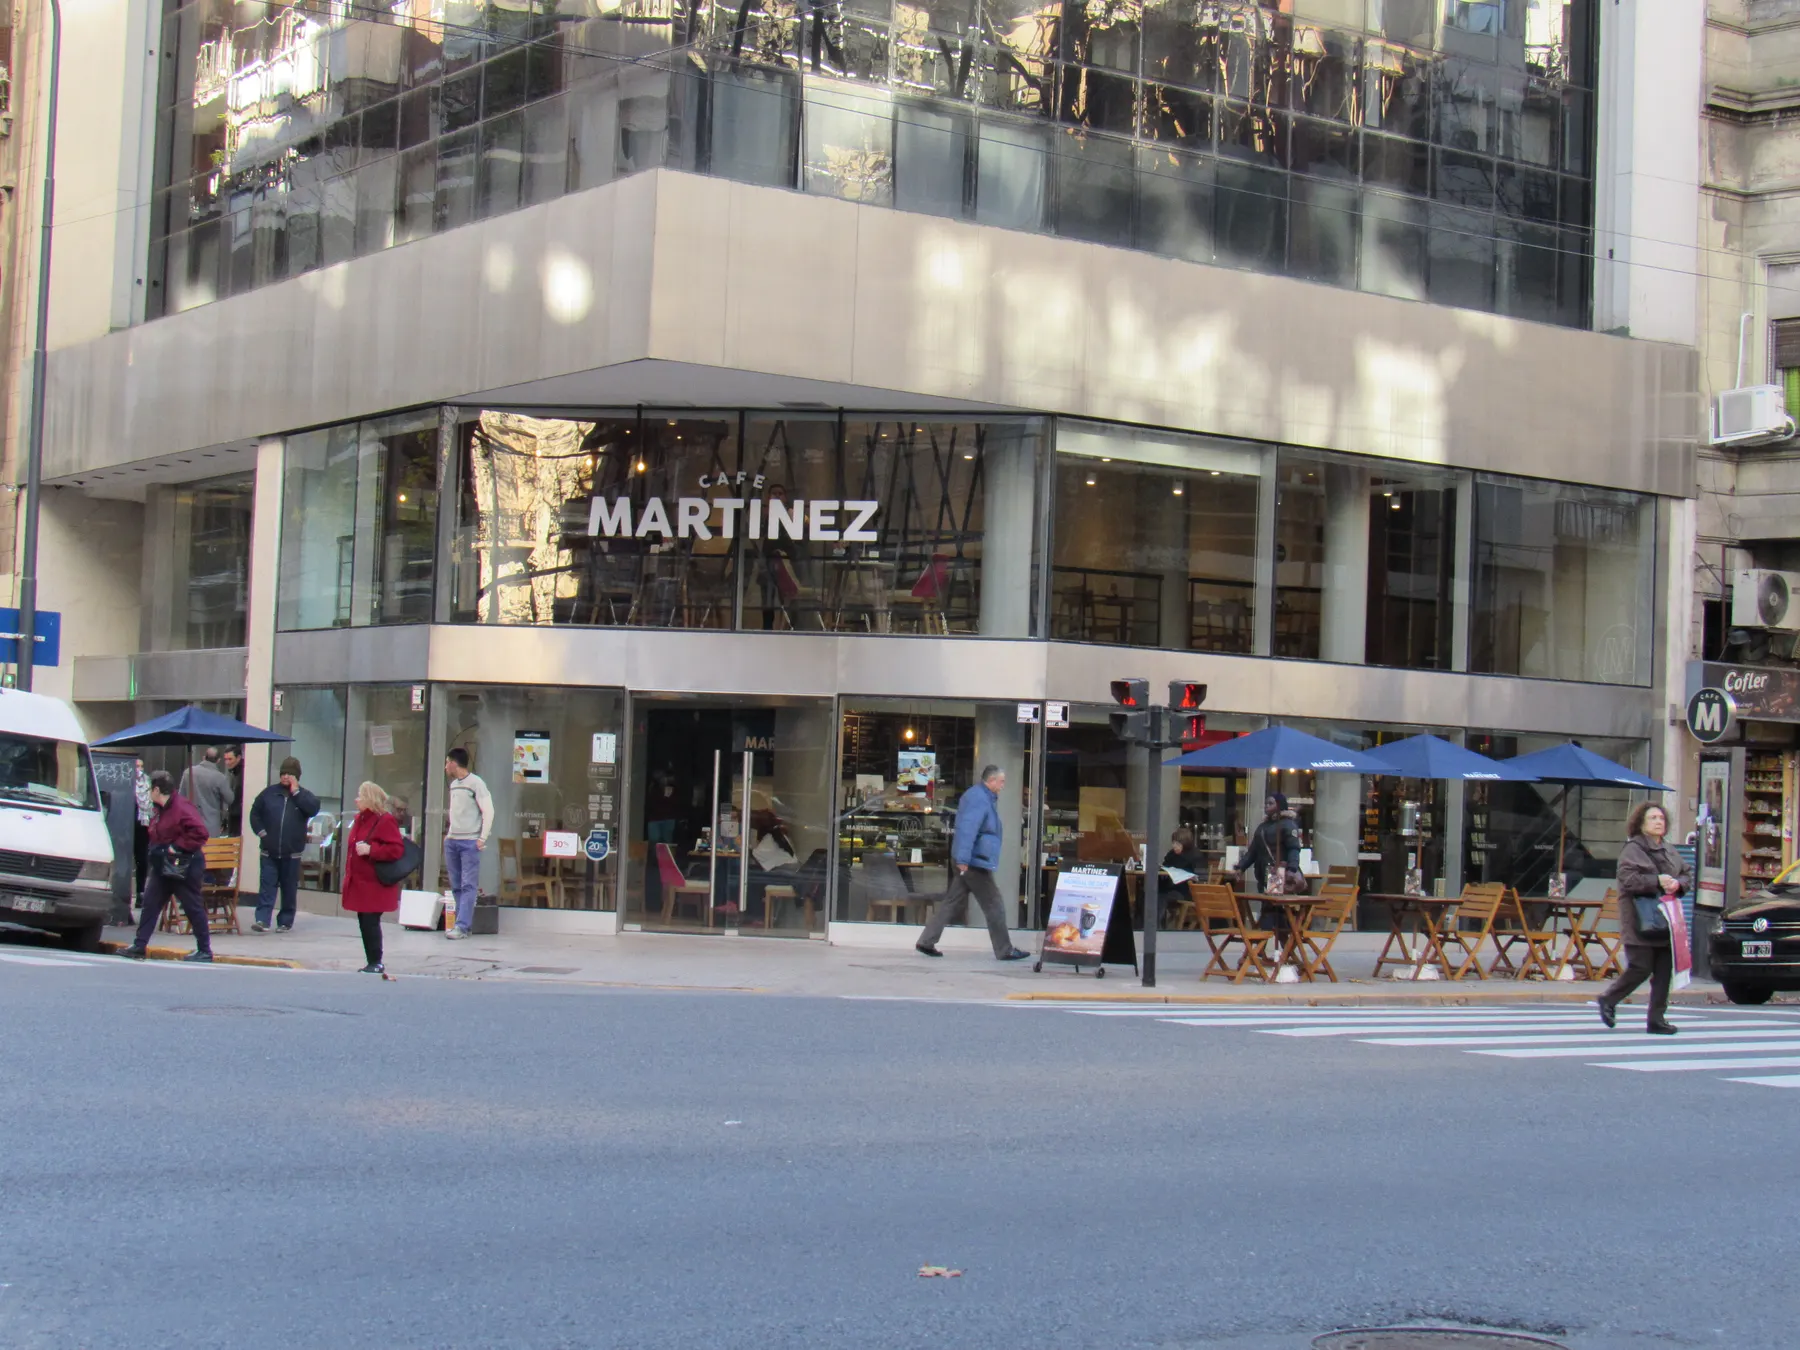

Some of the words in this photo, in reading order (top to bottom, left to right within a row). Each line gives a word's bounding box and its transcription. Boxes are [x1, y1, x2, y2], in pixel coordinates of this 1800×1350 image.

[699, 471, 765, 489] CAFE
[588, 496, 878, 541] MARTINEZ
[1725, 671, 1768, 692] Cofler
[1700, 693, 1720, 701] CAFE
[1695, 702, 1721, 732] M
[1071, 866, 1109, 876] MARTINEZ
